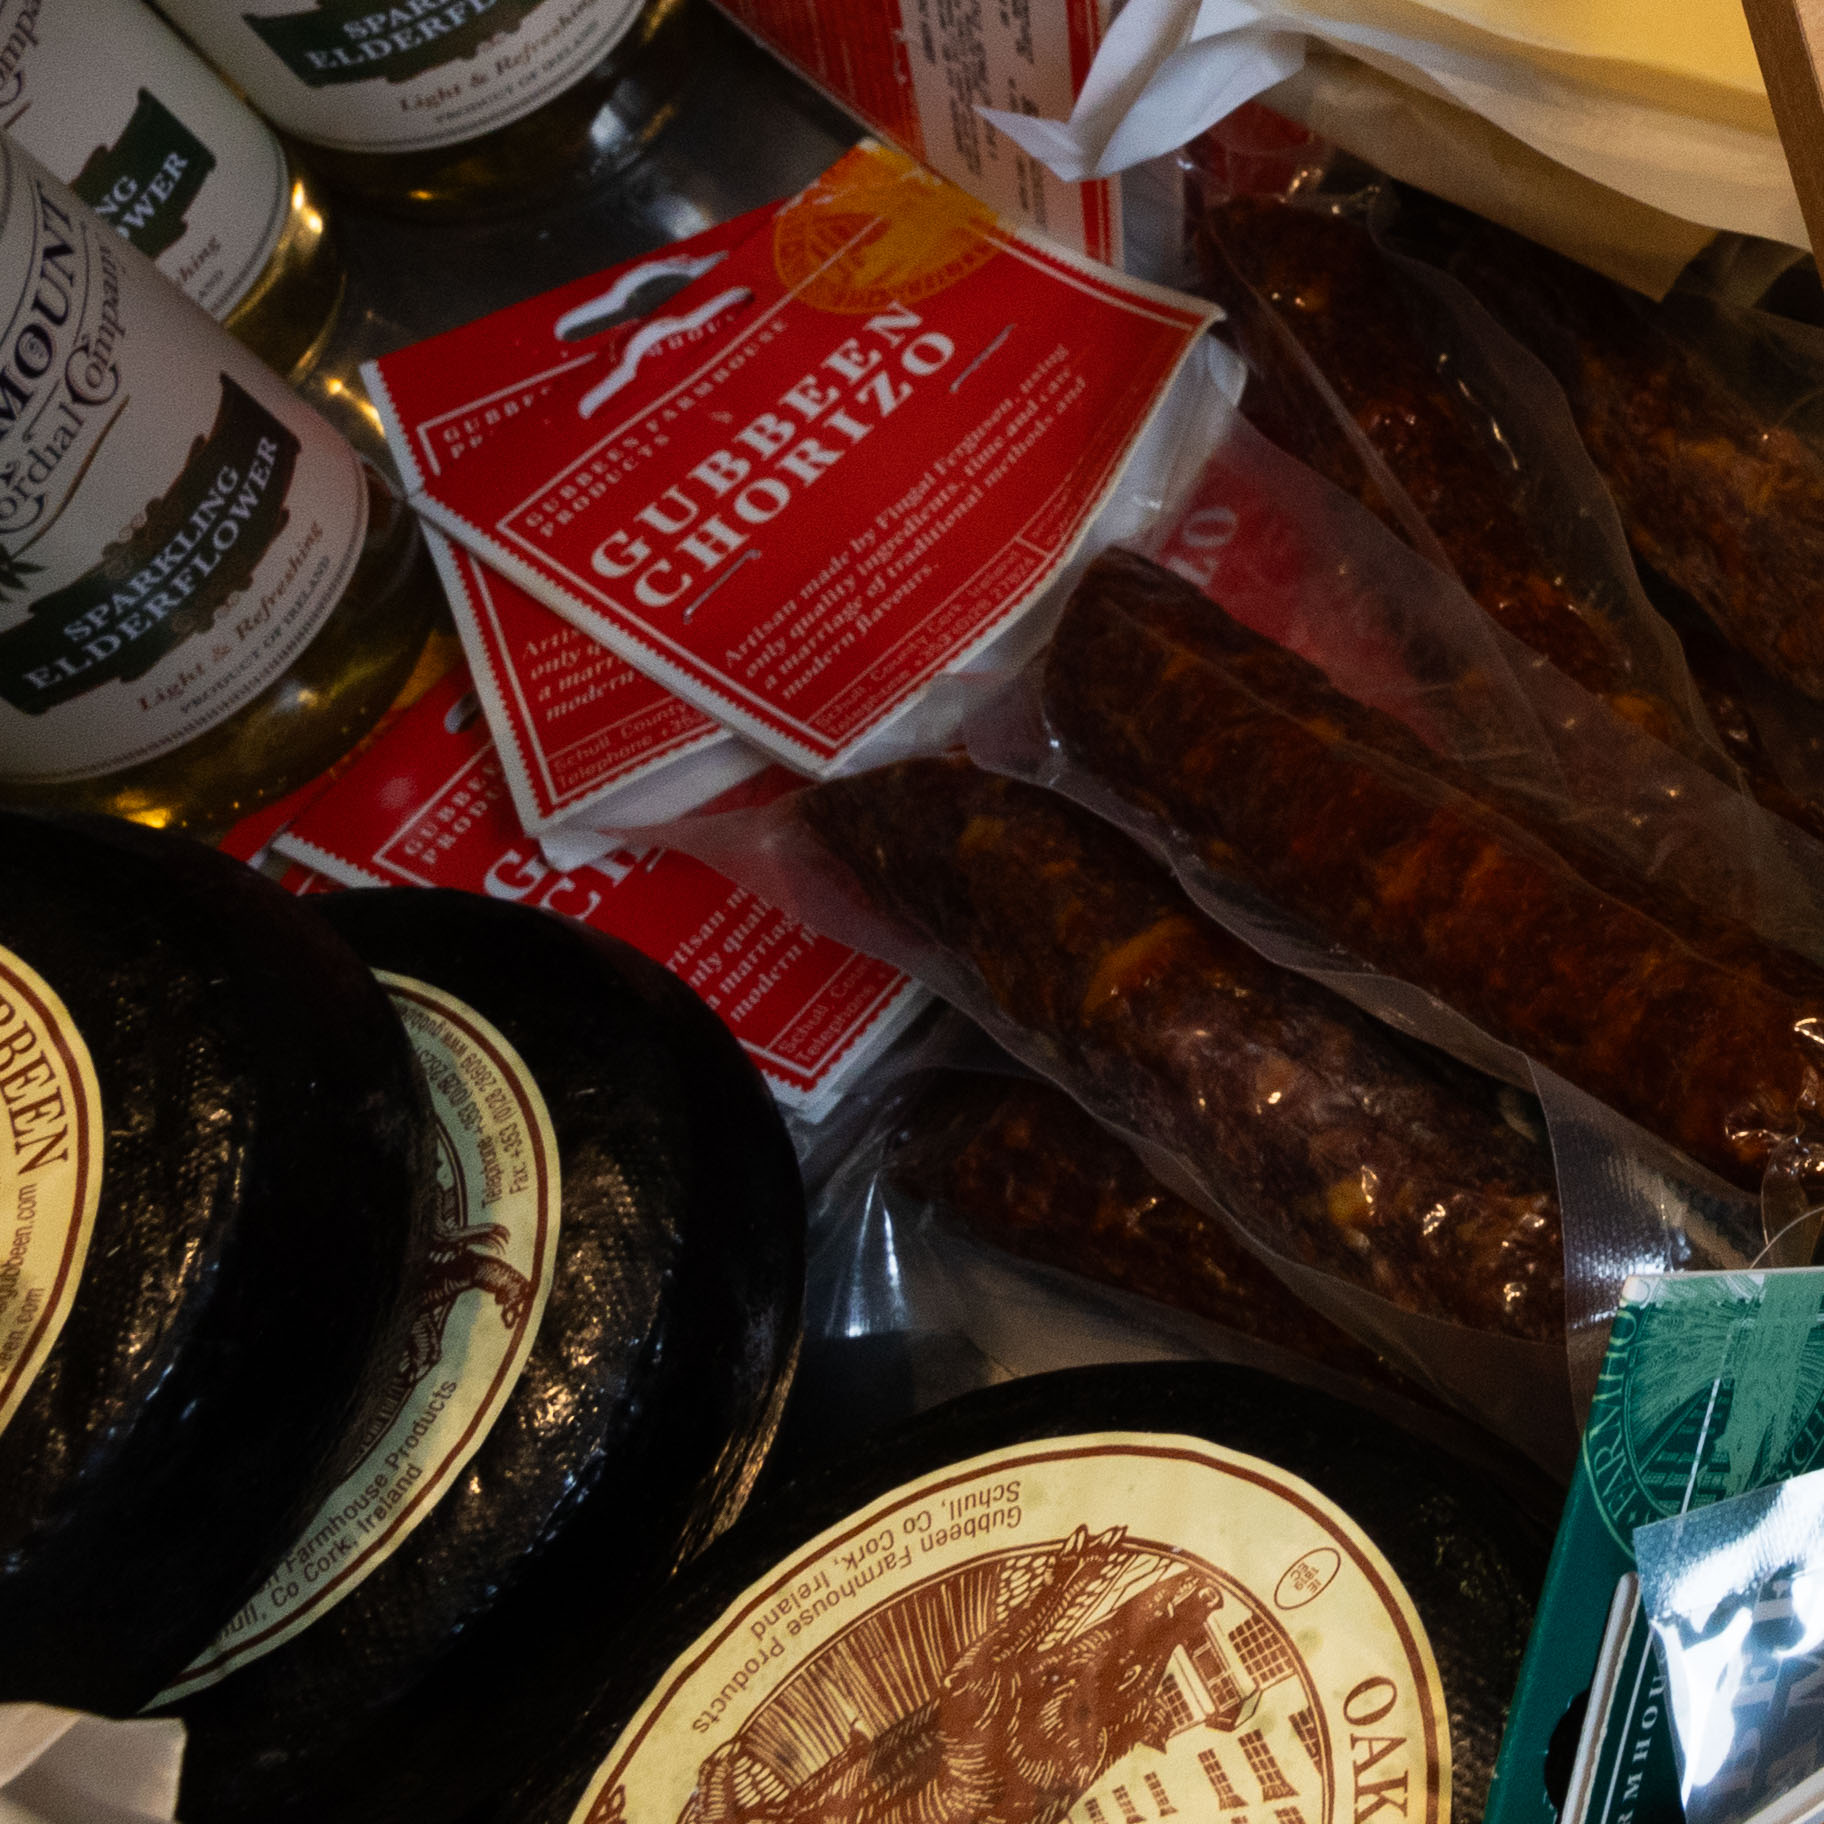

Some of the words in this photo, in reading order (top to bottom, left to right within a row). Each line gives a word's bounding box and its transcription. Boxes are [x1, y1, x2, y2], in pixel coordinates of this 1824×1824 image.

[397, 73, 464, 118] Light
[540, 433, 670, 537] PRODUCTS
[590, 298, 928, 582] GUBBEEN
[632, 328, 959, 610] CHORIZO
[62, 464, 241, 645] SPARKLING
[850, 527, 877, 554] by
[875, 473, 936, 529] Fingal
[23, 437, 283, 694] ELDERFLOWER
[233, 520, 325, 645] Refreshing
[746, 636, 787, 678] only
[790, 577, 857, 640] quality
[778, 594, 863, 674] marriage
[867, 573, 887, 599] of
[781, 632, 855, 700] modern
[384, 1379, 458, 1473] Products
[270, 1582, 300, 1608] Co
[303, 1534, 360, 1584] Cork,
[357, 1464, 423, 1535] Ireland
[902, 1508, 932, 1535] Co
[920, 1505, 1022, 1554] Gubbeen
[941, 1480, 1022, 1520] Schull,
[787, 1544, 913, 1638] Farmhouse
[833, 1533, 896, 1572] Cork,
[750, 1570, 831, 1643] Ireland
[692, 1637, 786, 1735] Products
[1343, 1675, 1409, 1824] OAK
